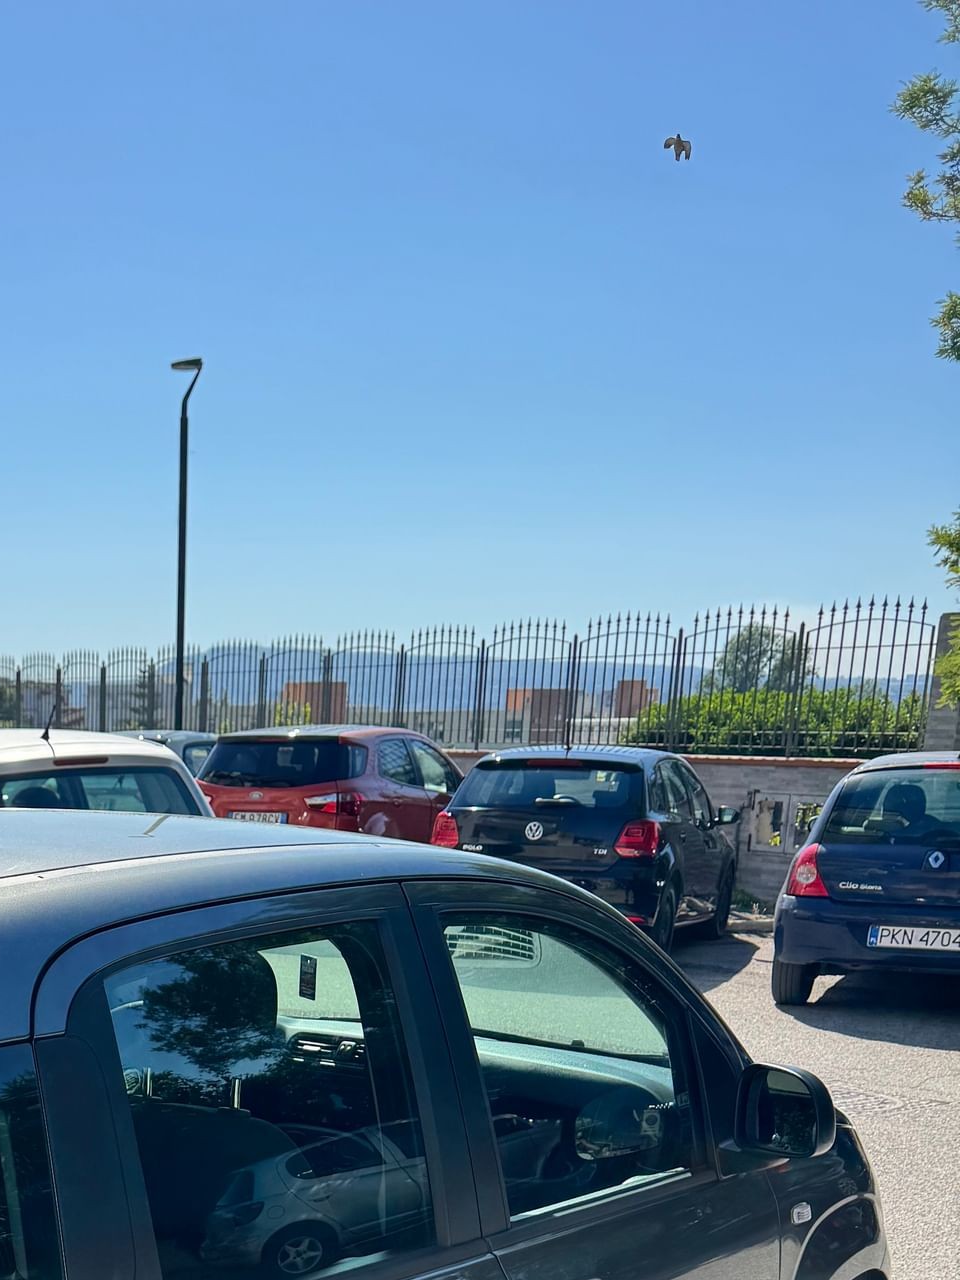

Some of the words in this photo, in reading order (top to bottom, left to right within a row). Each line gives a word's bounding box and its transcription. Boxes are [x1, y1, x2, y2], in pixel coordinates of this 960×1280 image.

[462, 843, 483, 851] POLO
[839, 881, 859, 889] Clio
[879, 928, 915, 945] PKN
[919, 930, 960, 948] 4704
